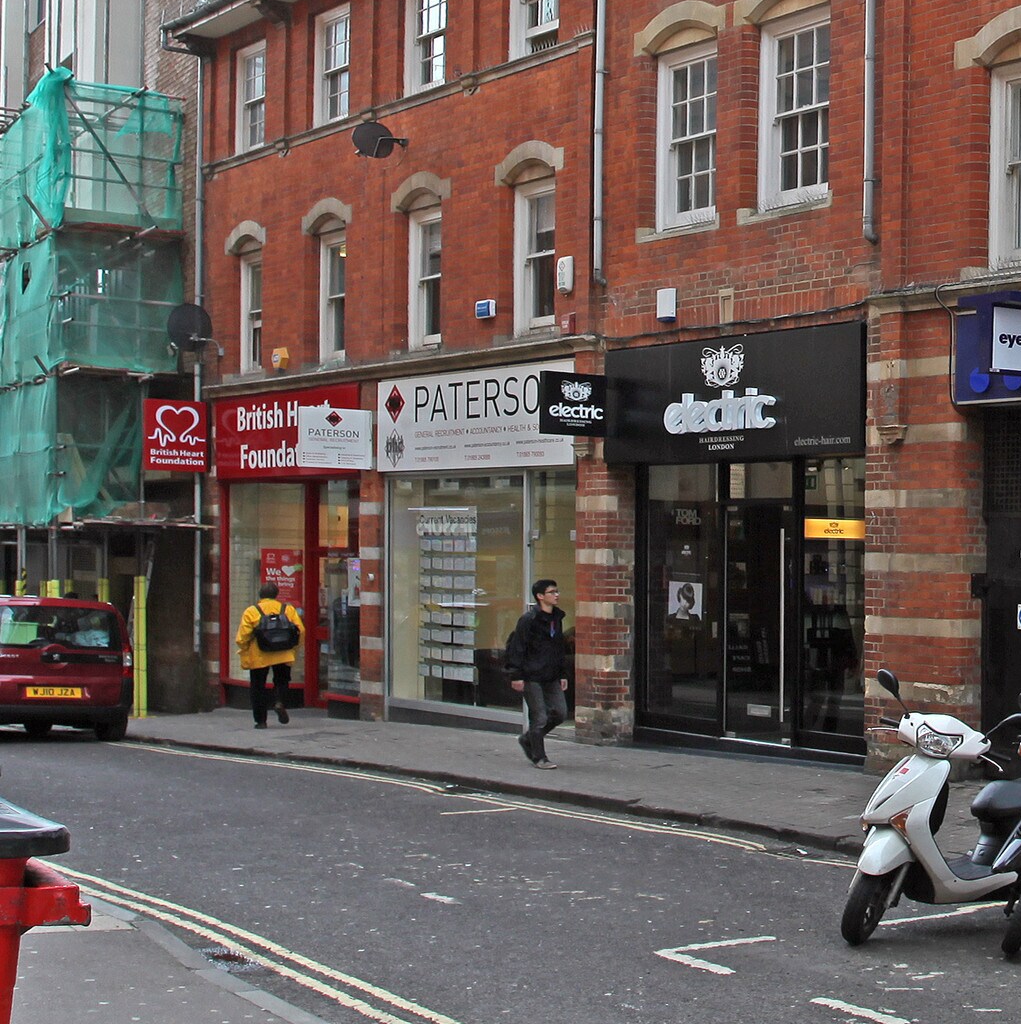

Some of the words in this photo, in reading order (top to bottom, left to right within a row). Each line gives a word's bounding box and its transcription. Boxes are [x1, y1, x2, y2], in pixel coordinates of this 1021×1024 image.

[413, 374, 540, 424] PATERSO
[237, 401, 283, 431] British
[548, 402, 604, 420] electric
[663, 387, 777, 435] electric
[308, 428, 360, 438] PATERSON
[507, 424, 527, 433] HEALTH
[699, 435, 745, 444] HAIRDRESSING
[793, 435, 851, 447] electric-hair.com
[708, 443, 735, 451] LONDON
[149, 448, 179, 457] British
[179, 449, 204, 458] Heart
[240, 440, 301, 469] Foundat
[150, 456, 204, 466] Foundation
[675, 508, 698, 517] TOM
[419, 515, 444, 524] Current
[445, 514, 477, 524] Vacancies
[675, 516, 702, 526] FORD
[265, 567, 282, 576] We
[33, 687, 55, 697] WJ10
[57, 687, 76, 697] JZA
